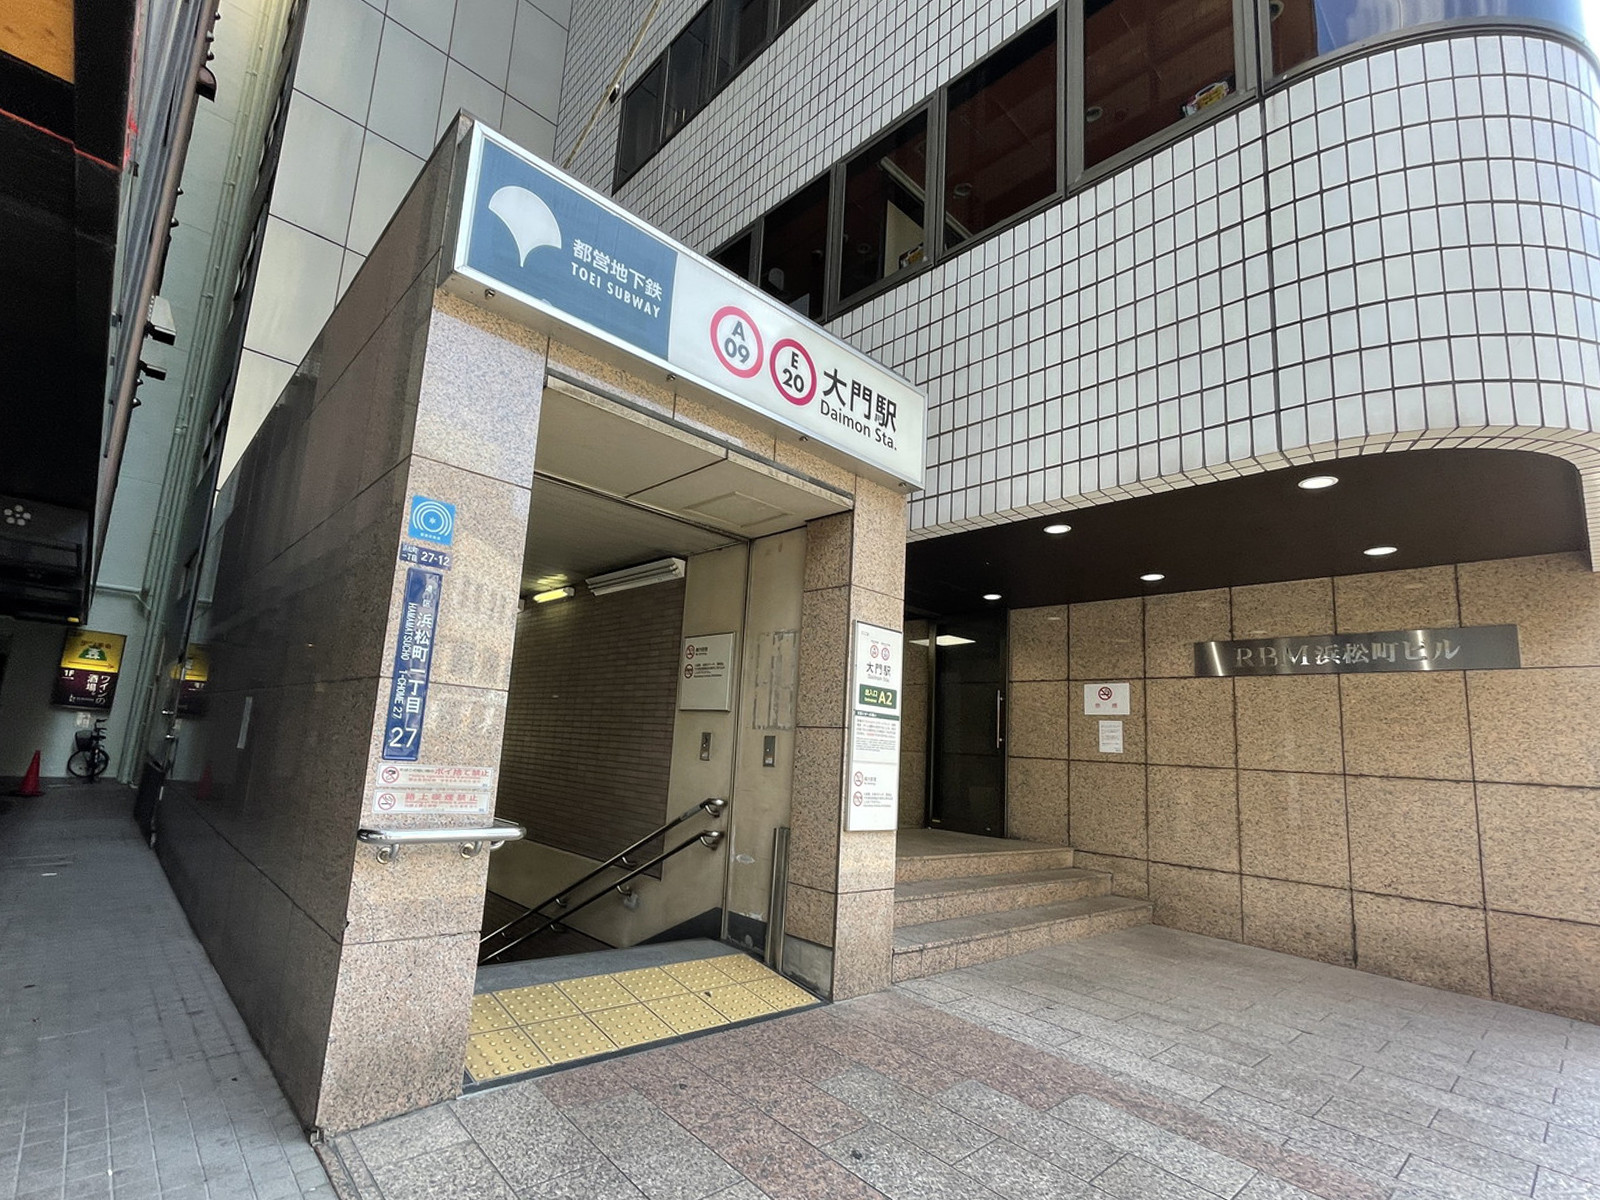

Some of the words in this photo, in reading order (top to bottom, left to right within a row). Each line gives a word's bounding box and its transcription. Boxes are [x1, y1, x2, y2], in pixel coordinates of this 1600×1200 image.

[573, 239, 662, 301] 都営地下鉄
[571, 262, 601, 289] TOEI
[607, 282, 660, 318] SUBWAY
[731, 320, 746, 342] A
[724, 337, 750, 364] 09
[791, 351, 799, 370] E
[782, 368, 805, 393] 20
[823, 368, 897, 433] 大門駅
[820, 399, 871, 438] Daimon
[875, 428, 897, 450] Sta.
[420, 551, 450, 567] 27-12
[400, 602, 417, 661] HAMAMATSUCHO
[406, 612, 433, 713] 浜松町一丁目
[95, 675, 111, 705] ワインの
[394, 669, 408, 705] 1-CHOME
[878, 690, 893, 706] A2
[389, 727, 417, 748] 27
